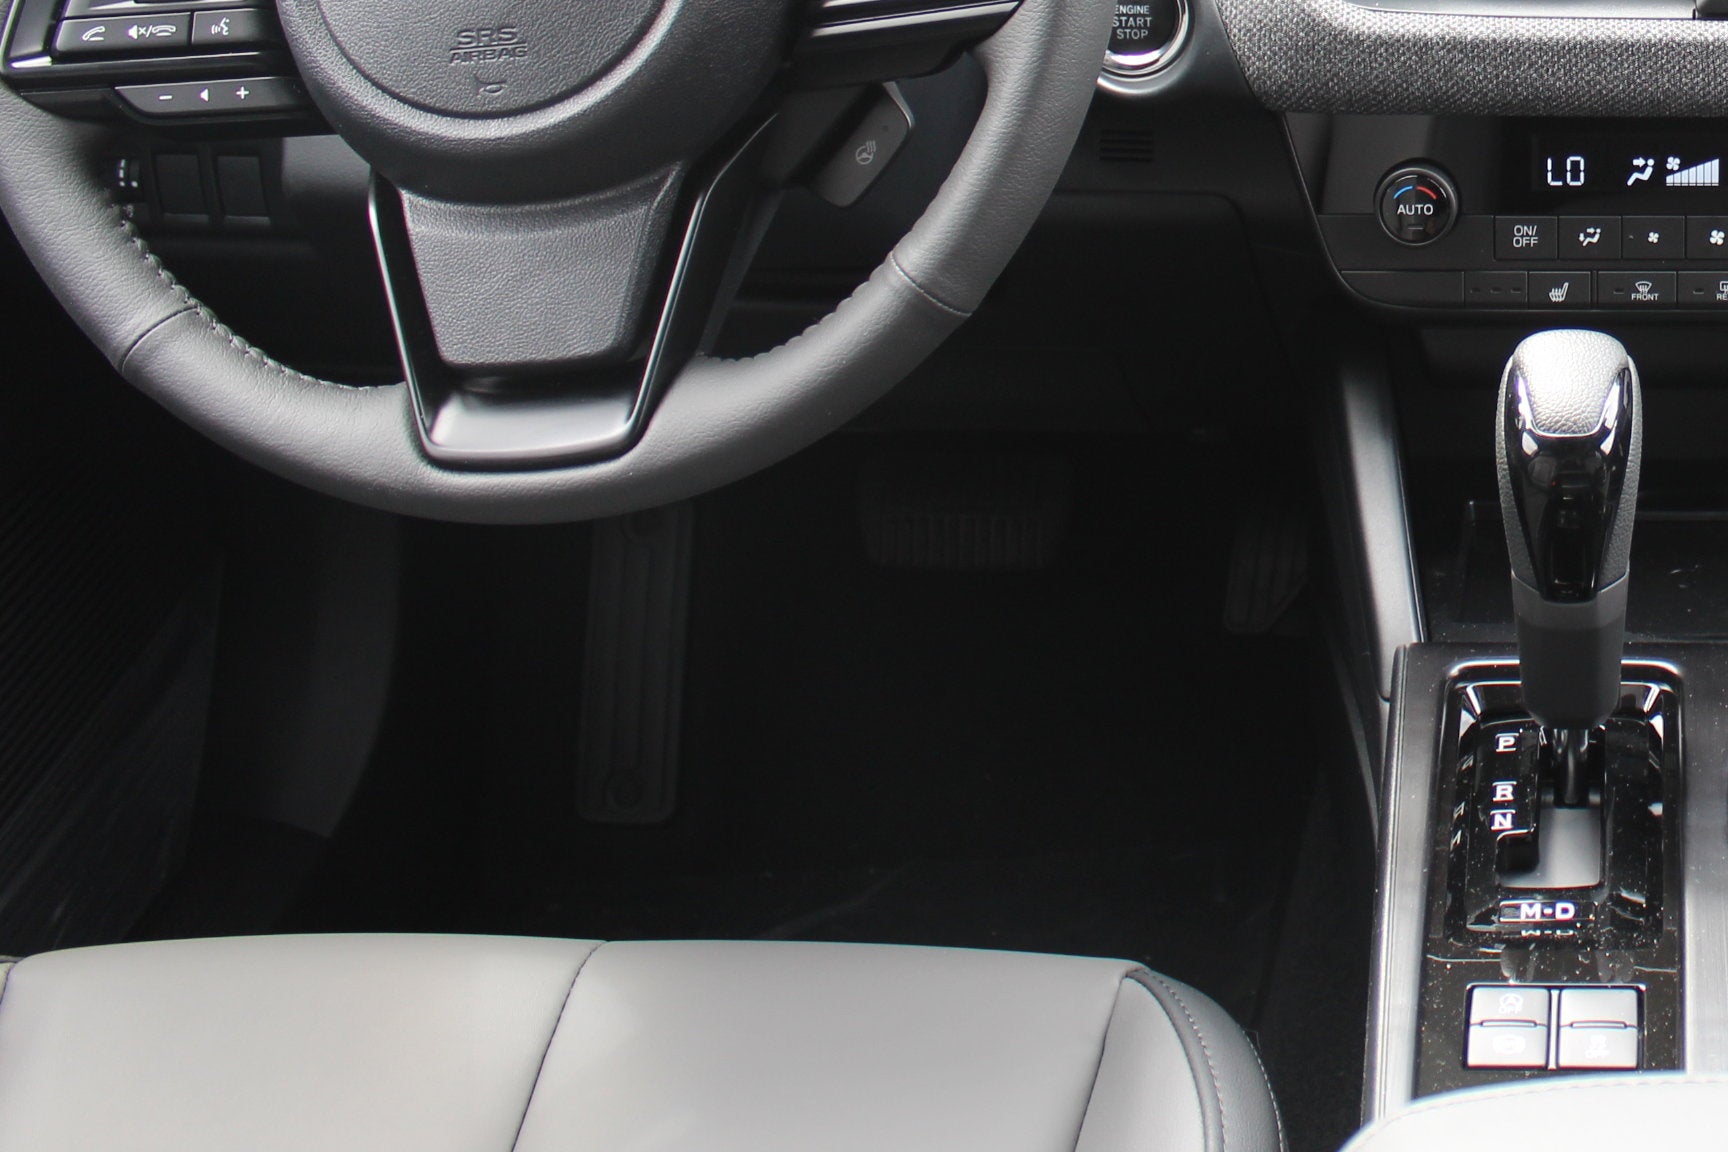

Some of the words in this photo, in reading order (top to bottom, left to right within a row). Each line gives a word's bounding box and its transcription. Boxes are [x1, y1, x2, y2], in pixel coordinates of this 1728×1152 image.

[1114, 4, 1150, 15] ENGINE
[1112, 16, 1152, 28] START
[1116, 29, 1148, 40] STOP
[1396, 204, 1434, 216] AUTO
[1513, 224, 1537, 236] ON/
[1513, 236, 1538, 248] OFF
[1631, 292, 1659, 301] FRONT
[1497, 735, 1516, 750] P
[1496, 785, 1514, 800] R
[1494, 814, 1513, 828] N
